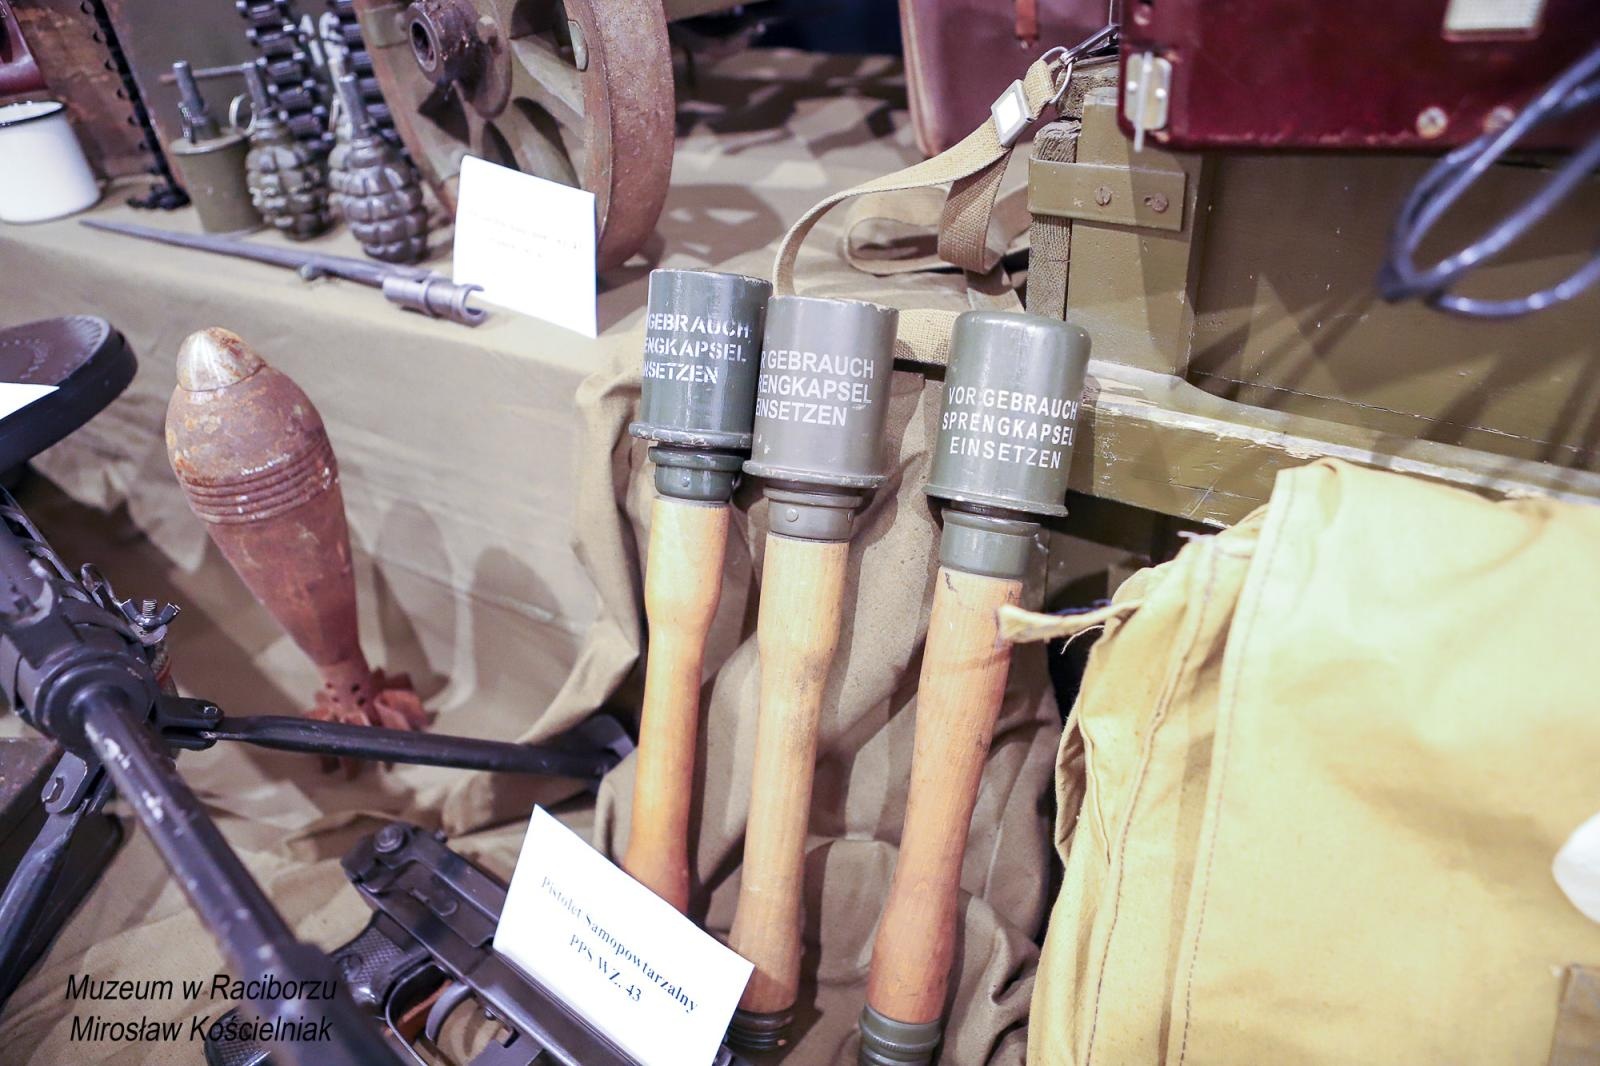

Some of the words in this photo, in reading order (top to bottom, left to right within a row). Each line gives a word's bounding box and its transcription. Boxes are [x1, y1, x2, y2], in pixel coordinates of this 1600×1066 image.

[768, 350, 874, 379] GEBRAUCH
[949, 386, 976, 405] VOR
[983, 389, 1079, 421] GEBRAUCH
[942, 412, 1074, 447] SPRENGKAPSEL
[950, 437, 1062, 469] EINSETZEN
[541, 875, 582, 918] Pistolet
[585, 914, 699, 1014] Samopowtarzalny
[570, 934, 594, 963] PPS
[626, 984, 643, 1002] 43
